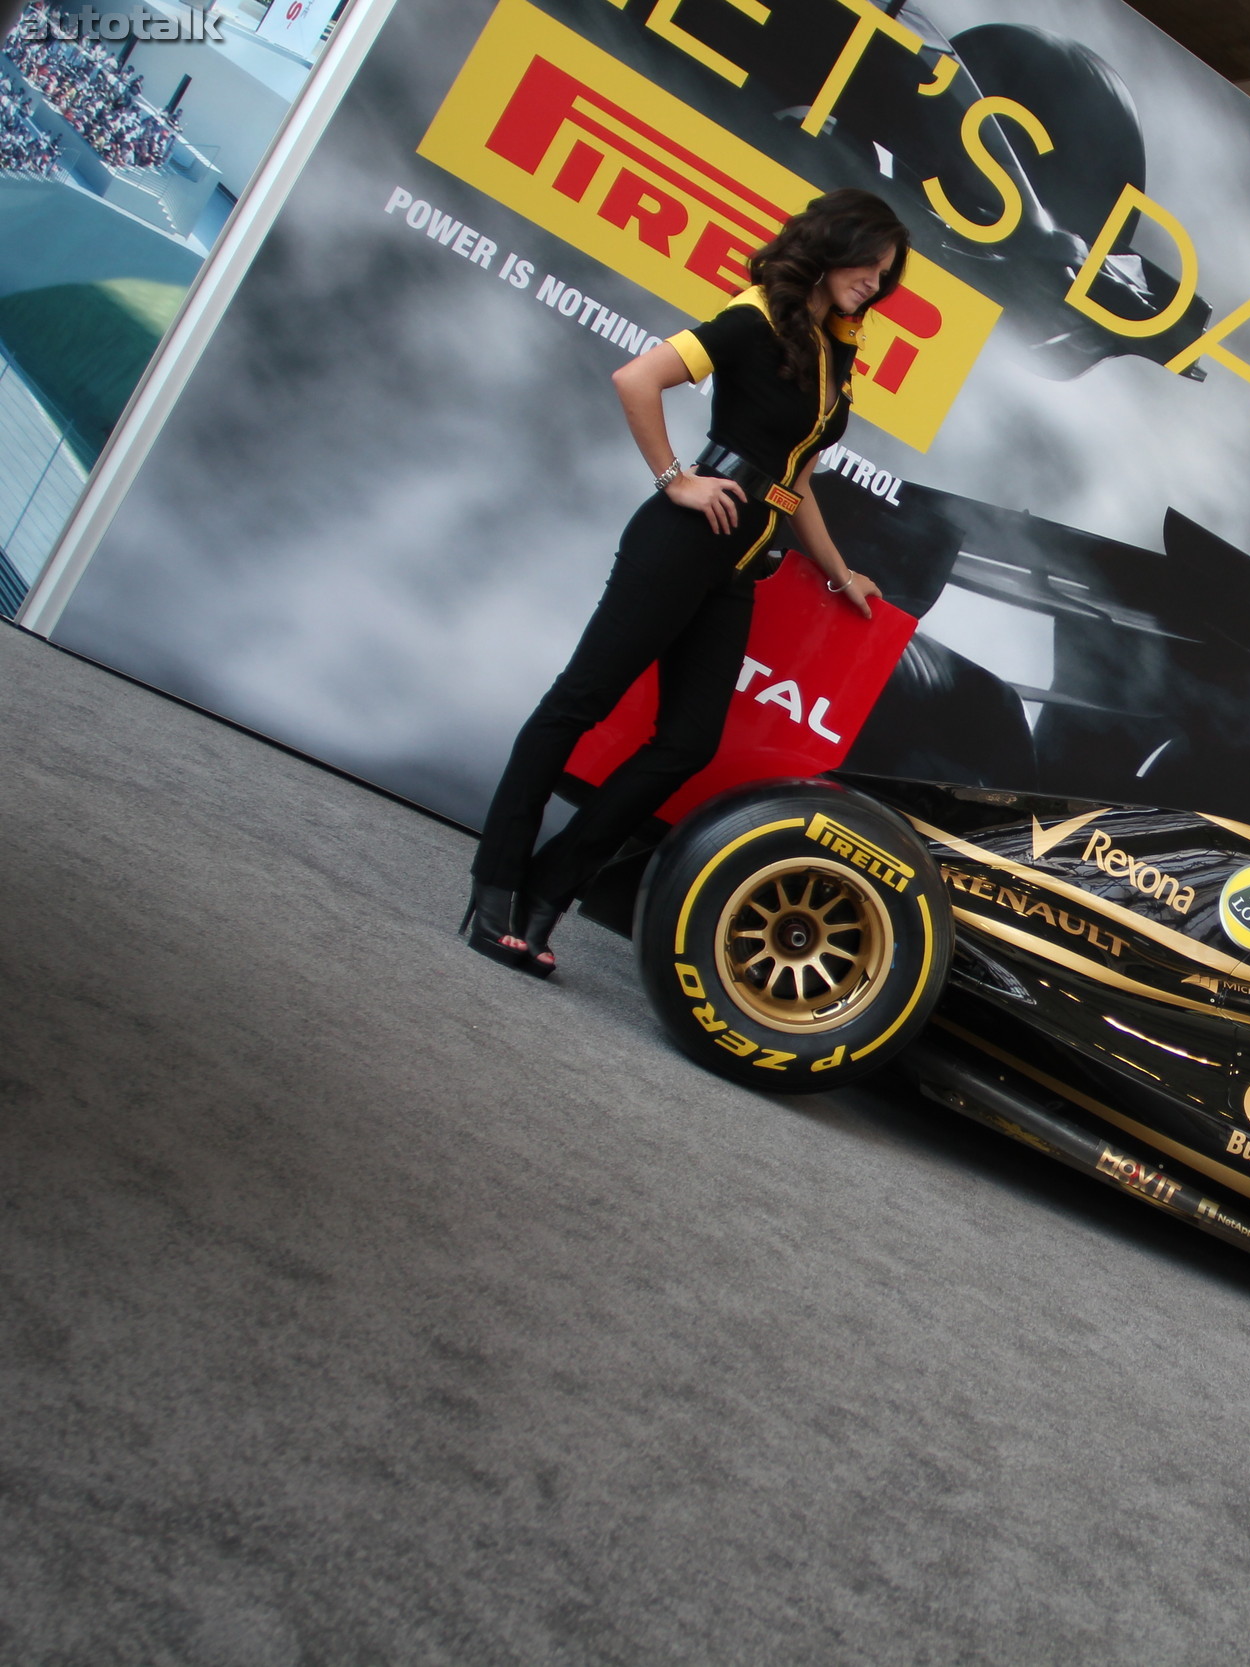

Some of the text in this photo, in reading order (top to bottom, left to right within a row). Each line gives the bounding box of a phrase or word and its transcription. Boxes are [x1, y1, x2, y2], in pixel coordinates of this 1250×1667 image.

[384, 186, 498, 270] POWER
[499, 253, 535, 289] IS
[769, 486, 799, 512] PIRELLI
[805, 812, 915, 893] PIRELLI
[1081, 828, 1196, 915] Rexona
[941, 867, 1131, 957] RENAULT
[674, 962, 846, 1073] P ZERO
